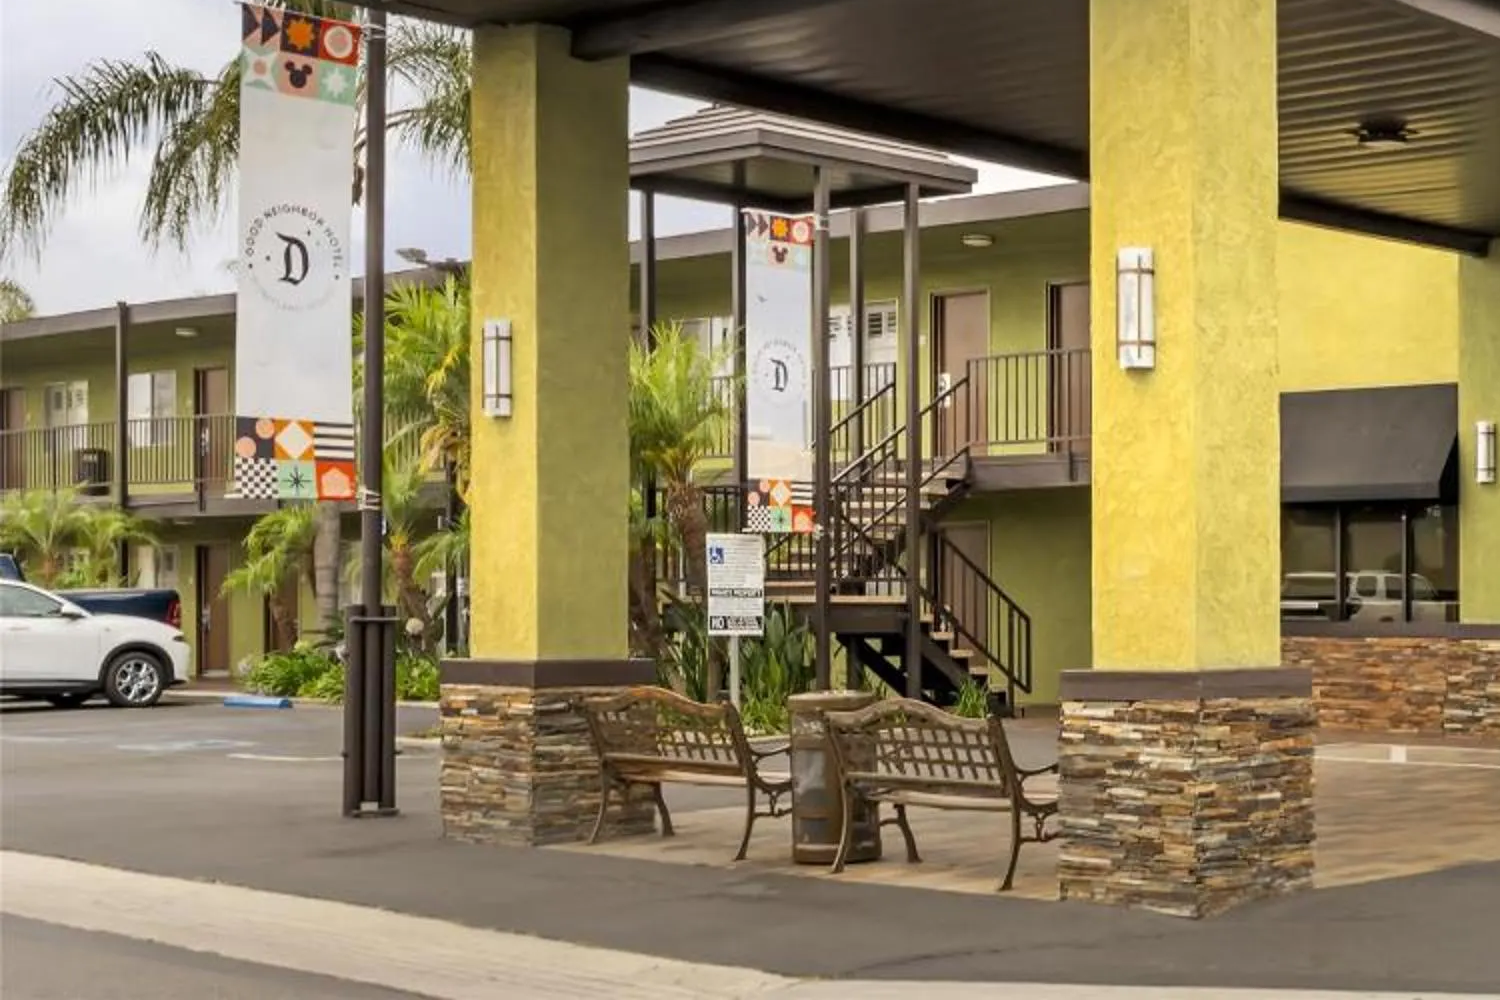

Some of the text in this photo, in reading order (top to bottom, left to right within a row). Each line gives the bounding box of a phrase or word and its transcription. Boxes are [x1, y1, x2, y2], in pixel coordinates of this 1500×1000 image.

[245, 218, 263, 257] GOOD
[276, 231, 309, 286] D
[769, 358, 789, 392] D
